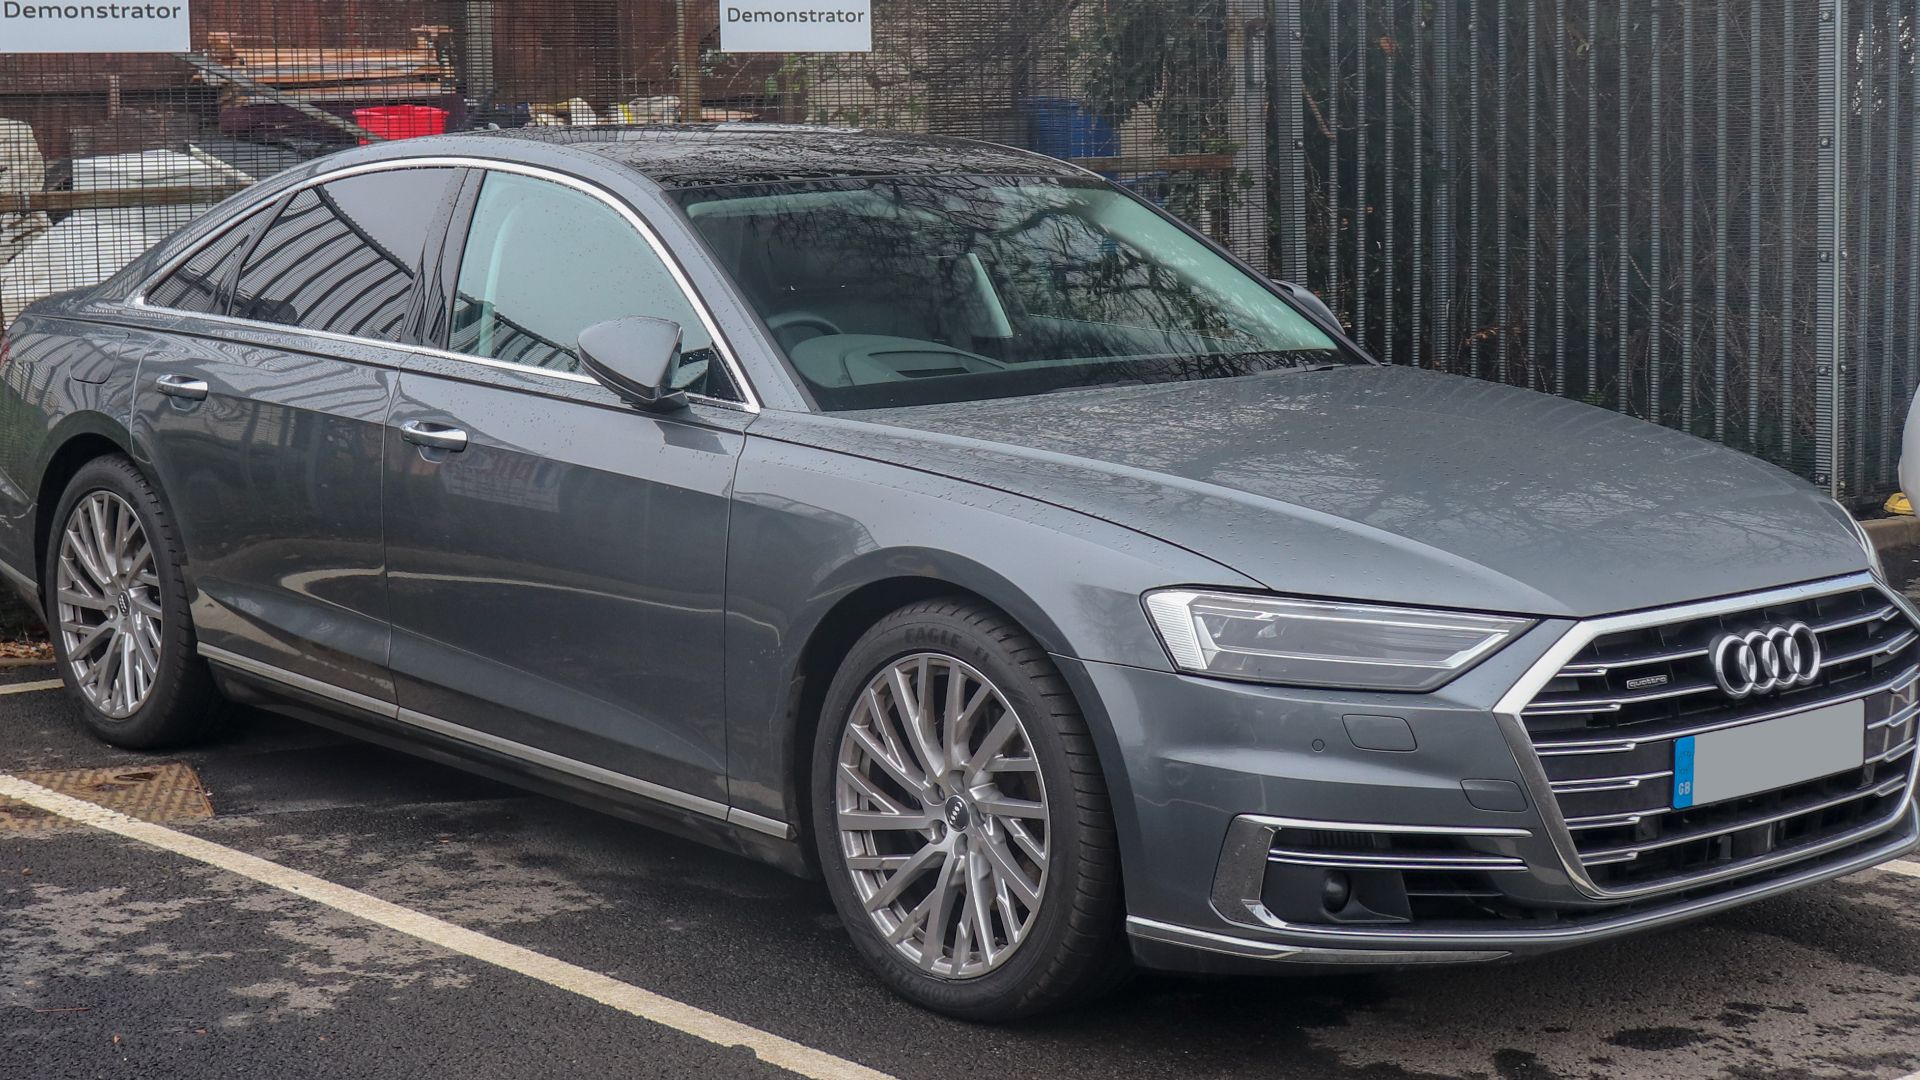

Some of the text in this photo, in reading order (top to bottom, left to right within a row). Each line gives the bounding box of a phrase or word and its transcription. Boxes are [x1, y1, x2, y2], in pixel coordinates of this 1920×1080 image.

[4, 1, 181, 19] Demonstrator
[727, 7, 865, 23] Demonstrator
[904, 627, 962, 649] EAGLE
[1628, 676, 1667, 689] quattro
[1678, 781, 1691, 796] GB
